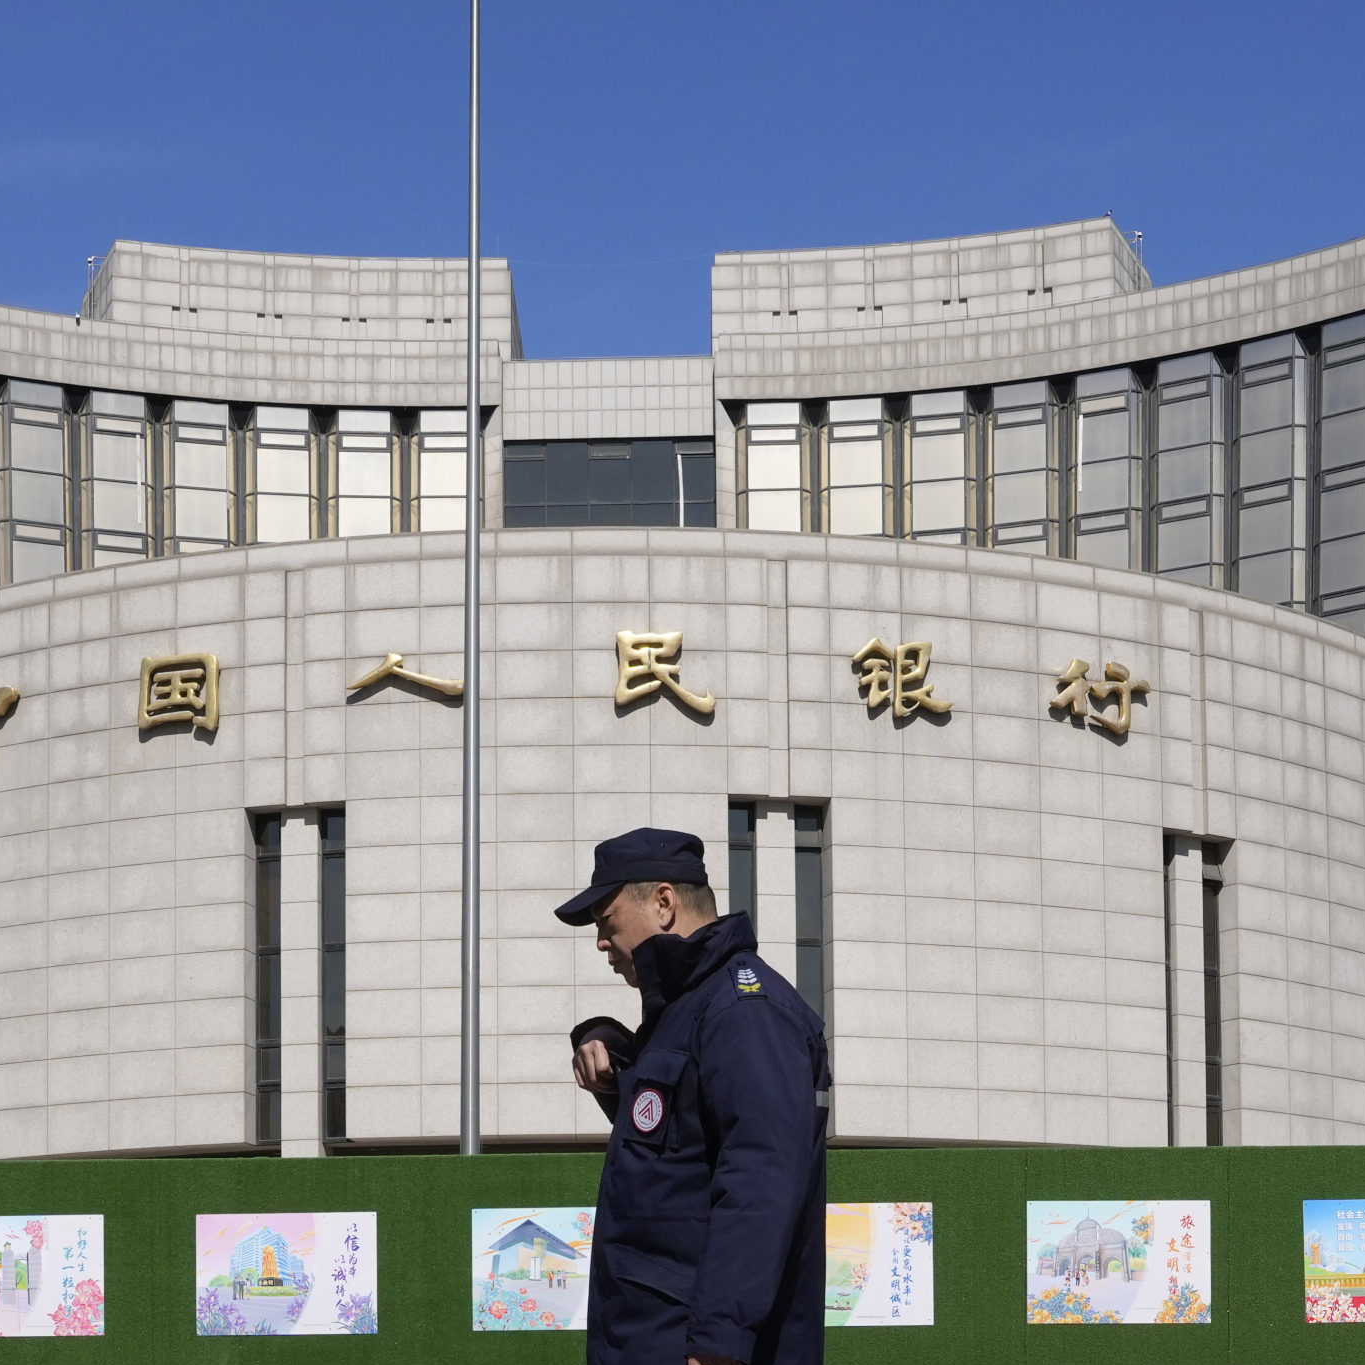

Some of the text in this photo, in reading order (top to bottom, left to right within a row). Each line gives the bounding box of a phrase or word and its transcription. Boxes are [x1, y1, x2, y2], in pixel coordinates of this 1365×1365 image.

[344, 1222, 360, 1278] 以信为本
[331, 1254, 348, 1309] 以诚待人
